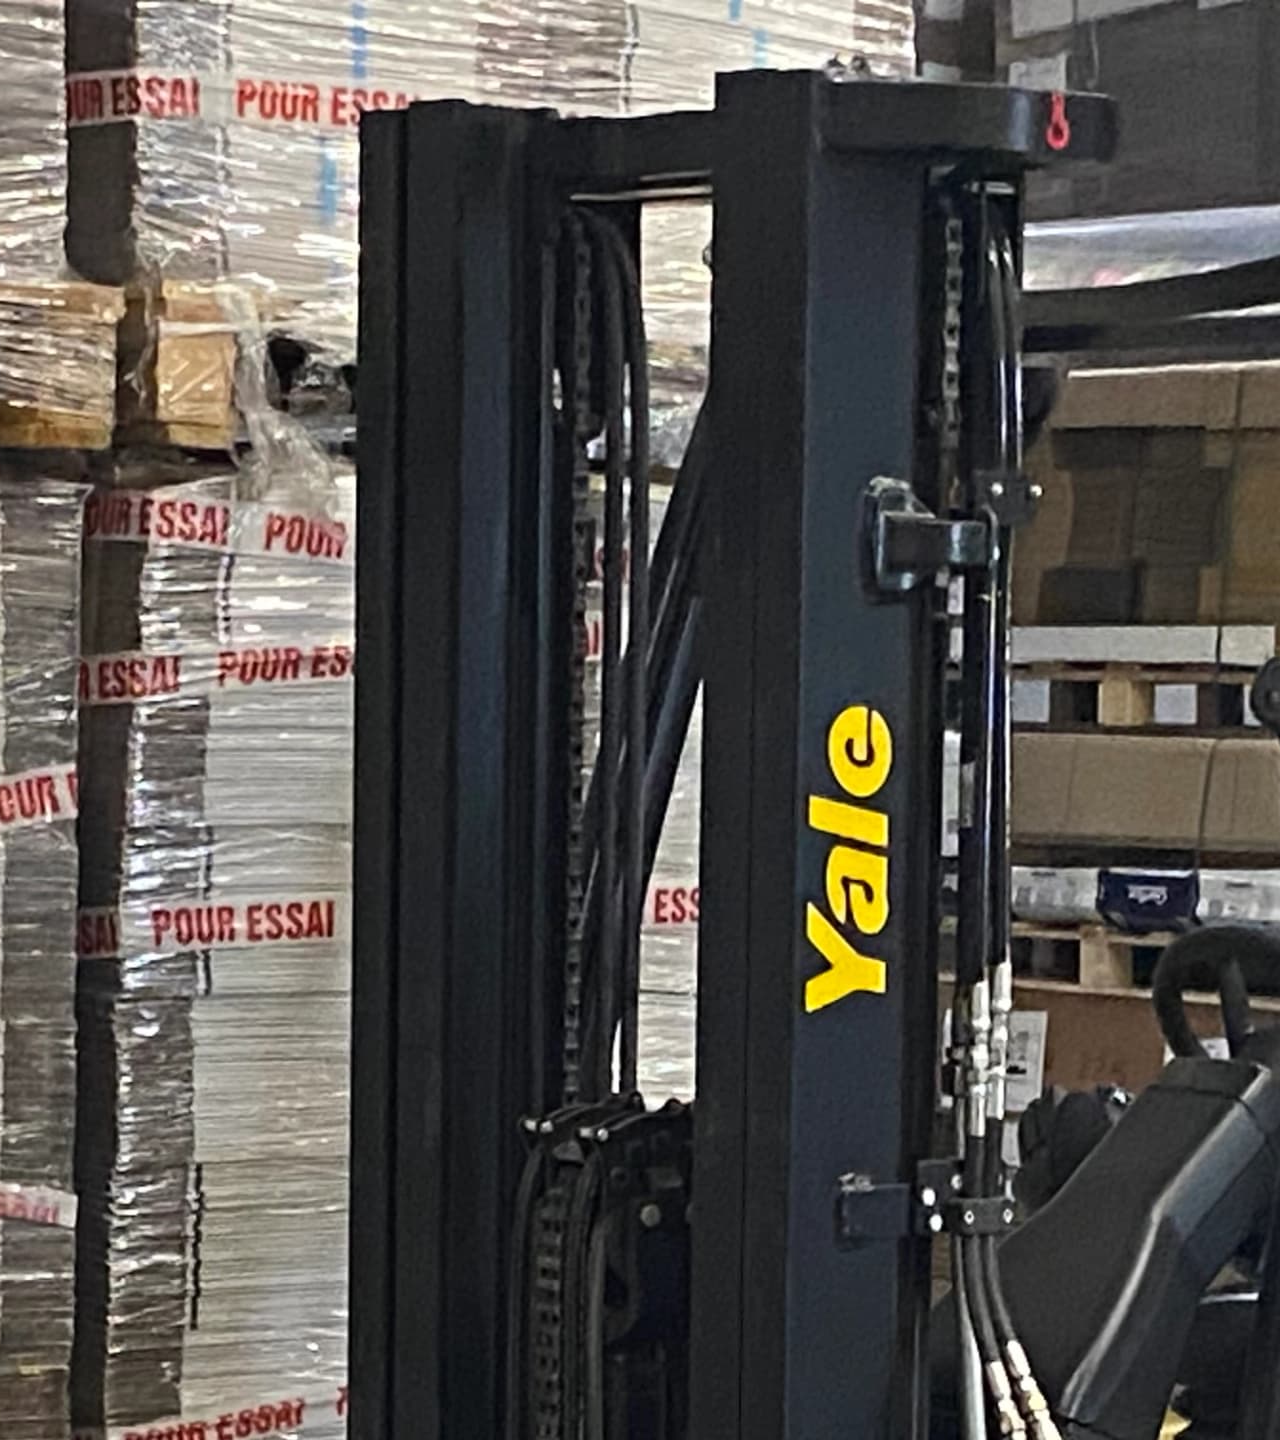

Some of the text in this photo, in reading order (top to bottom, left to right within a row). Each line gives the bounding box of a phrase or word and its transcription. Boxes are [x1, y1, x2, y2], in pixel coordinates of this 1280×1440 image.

[111, 76, 201, 118] ESSAI
[236, 78, 319, 123] POUR
[139, 497, 230, 546] ESSAI
[265, 510, 348, 559] POUR
[98, 654, 181, 699] ESSAI
[217, 645, 301, 690] POUR
[311, 644, 354, 679] ES
[805, 705, 892, 1014] Yale
[151, 905, 235, 947] POUR
[246, 899, 336, 942] ESSAI
